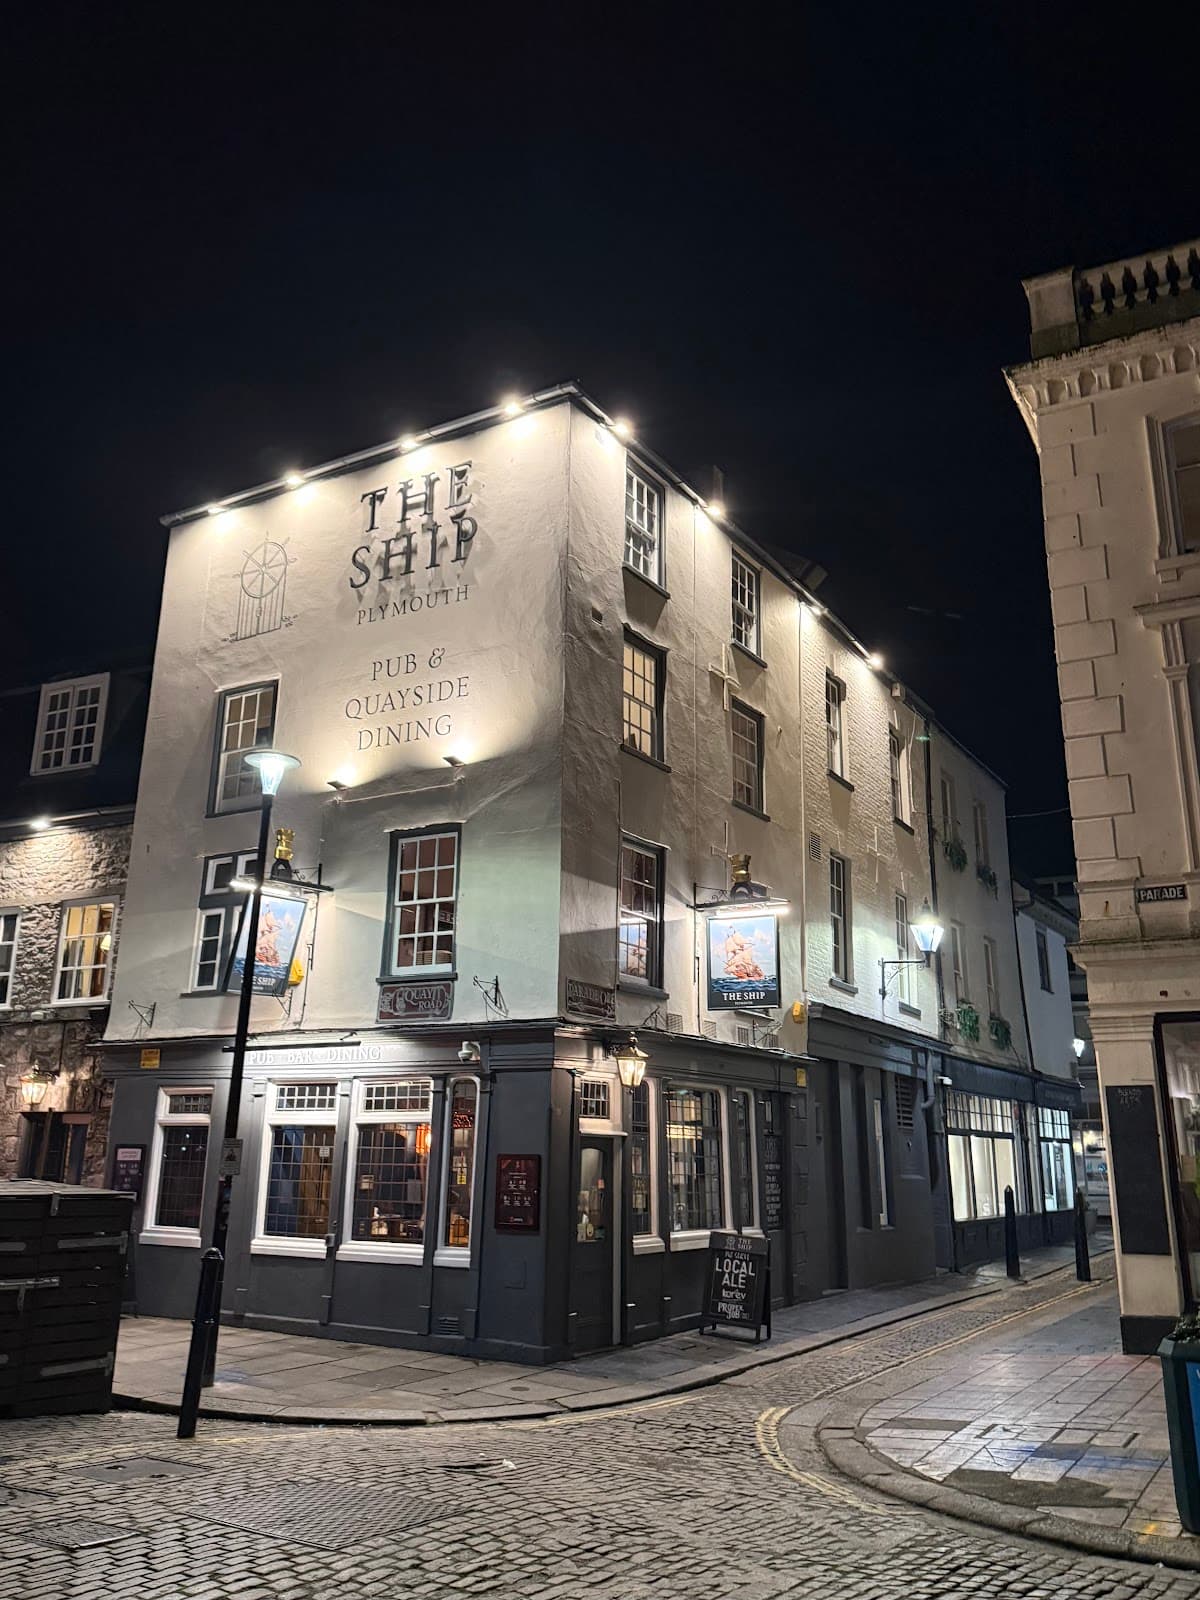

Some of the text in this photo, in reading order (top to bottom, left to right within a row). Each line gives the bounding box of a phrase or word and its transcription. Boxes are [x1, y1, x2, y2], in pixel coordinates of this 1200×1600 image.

[360, 460, 473, 532] THE
[349, 516, 478, 589] SHIP
[357, 584, 469, 625] PLYMOUTH
[371, 648, 446, 681] PUB &
[345, 676, 470, 720] QUAYSIDE
[358, 714, 452, 751] DINING
[405, 988, 433, 1005] QUAY
[722, 991, 766, 1000] THE SHIP
[327, 1046, 381, 1060] DINING
[716, 1258, 755, 1276] LOCAL
[722, 1272, 746, 1288] ALE
